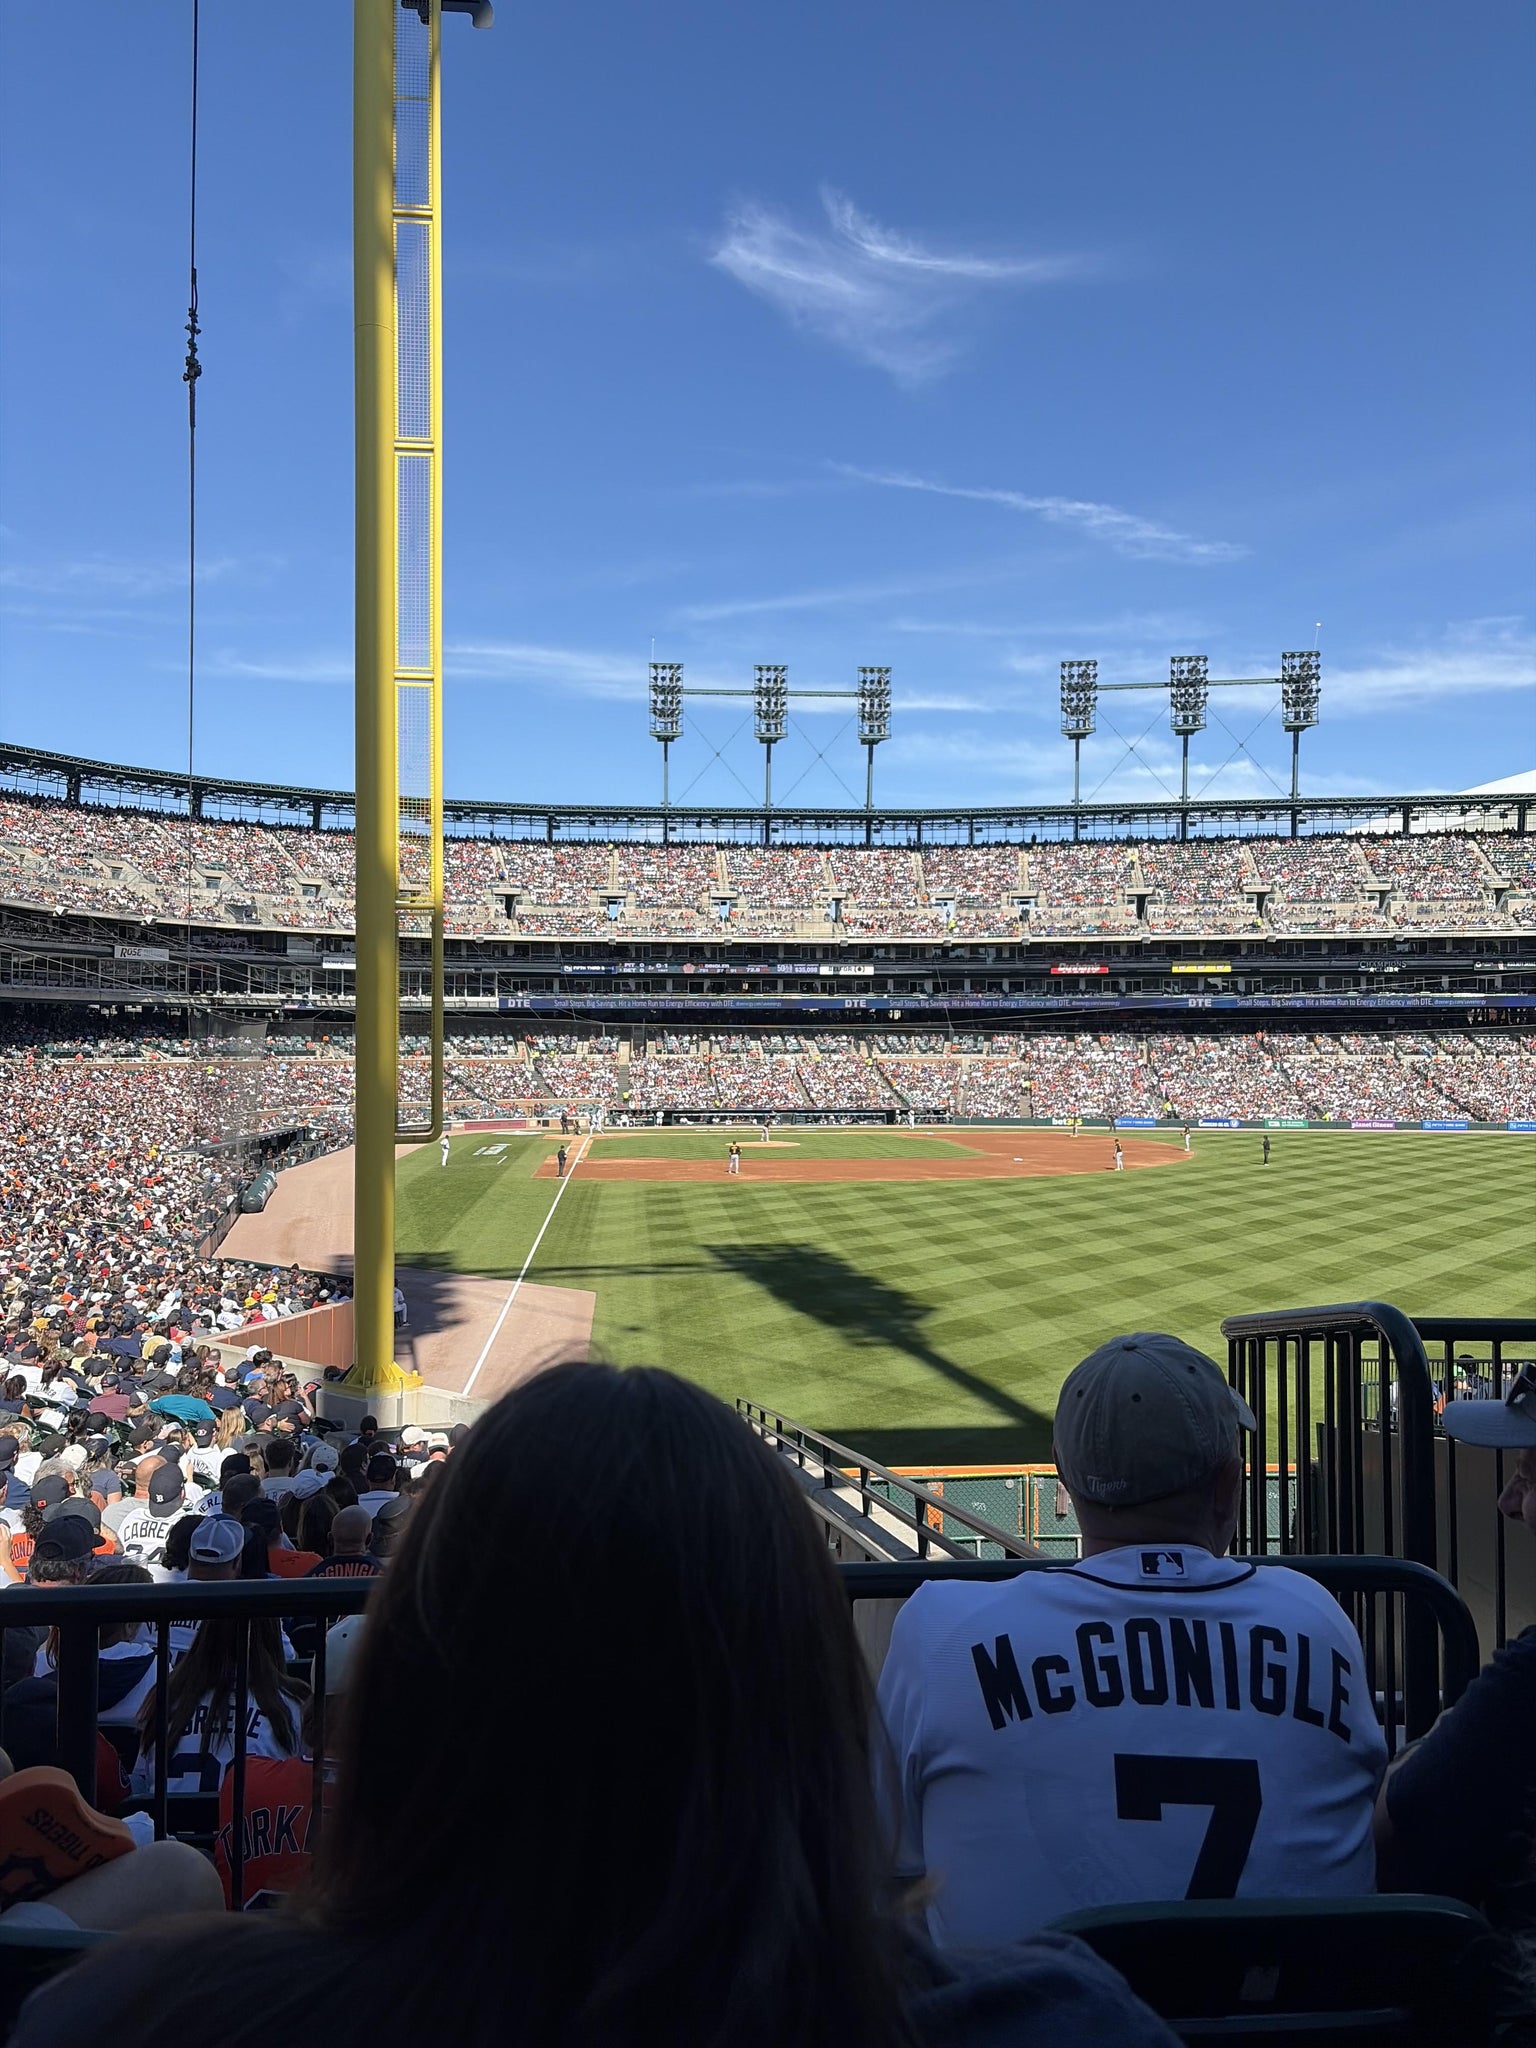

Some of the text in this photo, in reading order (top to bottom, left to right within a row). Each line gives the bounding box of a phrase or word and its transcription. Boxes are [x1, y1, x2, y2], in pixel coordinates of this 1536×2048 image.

[120, 947, 142, 958] ROSE
[1359, 960, 1408, 968] CHAMPIONS
[508, 999, 530, 1008] DTE
[587, 1000, 595, 1008] Big
[666, 1000, 684, 1008] Energy
[685, 1000, 710, 1008] Efficiency
[845, 999, 866, 1008] DTE
[920, 1000, 929, 1008] Big
[999, 1000, 1018, 1008] Energy
[1019, 1000, 1044, 1008] Efficiency
[1188, 998, 1212, 1007] DTE
[1271, 999, 1280, 1007] Big
[1356, 999, 1376, 1007] Energy
[1377, 999, 1405, 1007] Efficiency
[1087, 1475, 1127, 1497] Tigers
[312, 1561, 385, 1577] cGONIGL
[971, 1618, 1351, 1744] McGONIGLE
[1114, 1753, 1262, 1900] 7
[23, 1808, 91, 1862] TIGERS
[218, 1805, 314, 1871] TRK
